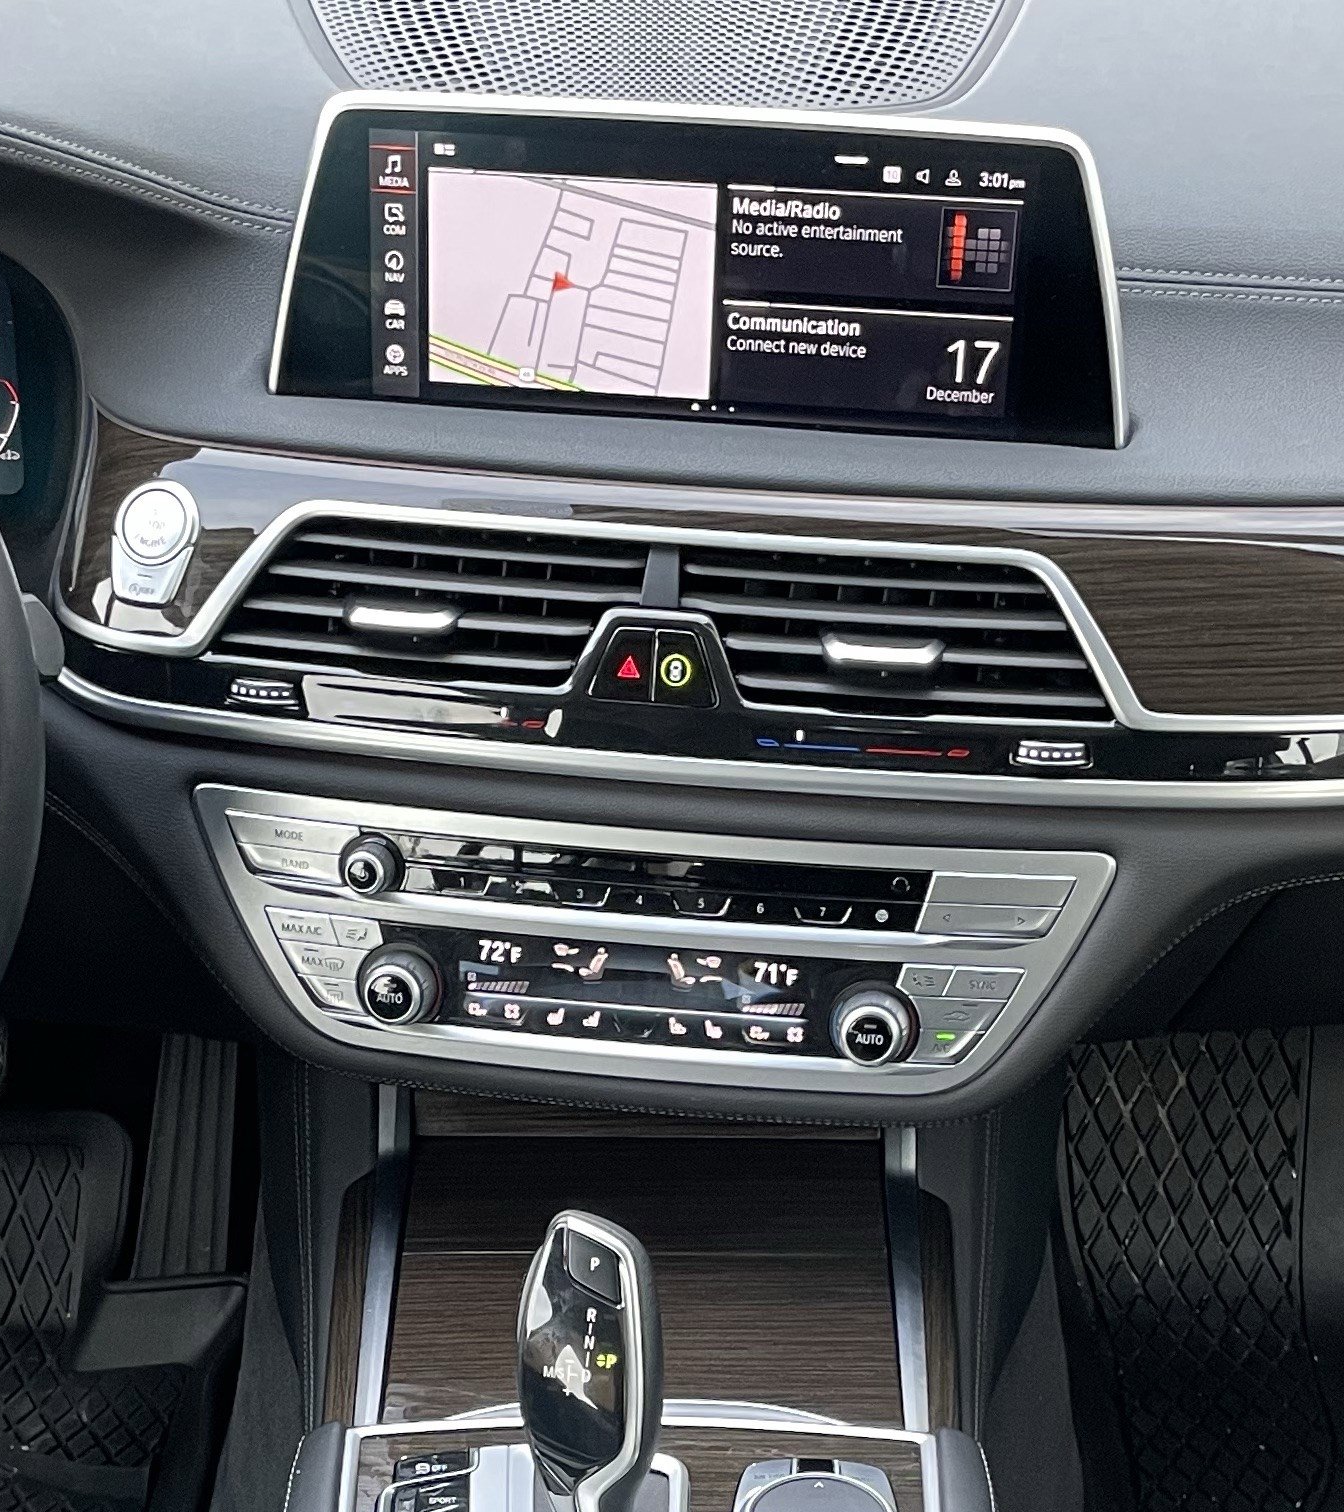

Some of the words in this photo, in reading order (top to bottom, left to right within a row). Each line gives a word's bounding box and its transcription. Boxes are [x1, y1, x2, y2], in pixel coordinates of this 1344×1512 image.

[379, 176, 409, 188] MEDIA
[732, 197, 841, 221] Media/Radio
[383, 225, 406, 236] COM
[732, 219, 753, 235] No
[756, 222, 798, 238] active
[801, 223, 903, 244] entertainment
[731, 241, 784, 258] source.
[384, 272, 405, 283] NAV
[385, 319, 405, 330] CAR
[727, 312, 861, 337] Communication
[727, 336, 786, 354] Connect
[789, 342, 817, 356] new
[821, 341, 867, 359] device
[947, 339, 1000, 385] 17
[383, 365, 408, 377] APPS
[926, 386, 995, 404] December
[274, 829, 303, 841] MODE
[459, 876, 465, 888] 1
[576, 888, 584, 899] 3
[635, 894, 643, 905] 4
[697, 898, 705, 909] 5
[756, 902, 765, 914] 6
[819, 906, 827, 917] 7
[376, 991, 403, 1006] AUTO
[855, 1033, 884, 1046] AUTO
[590, 1257, 601, 1271] P
[586, 1307, 597, 1323] R
[584, 1335, 595, 1350] N
[428, 1496, 457, 1504] SPORT
